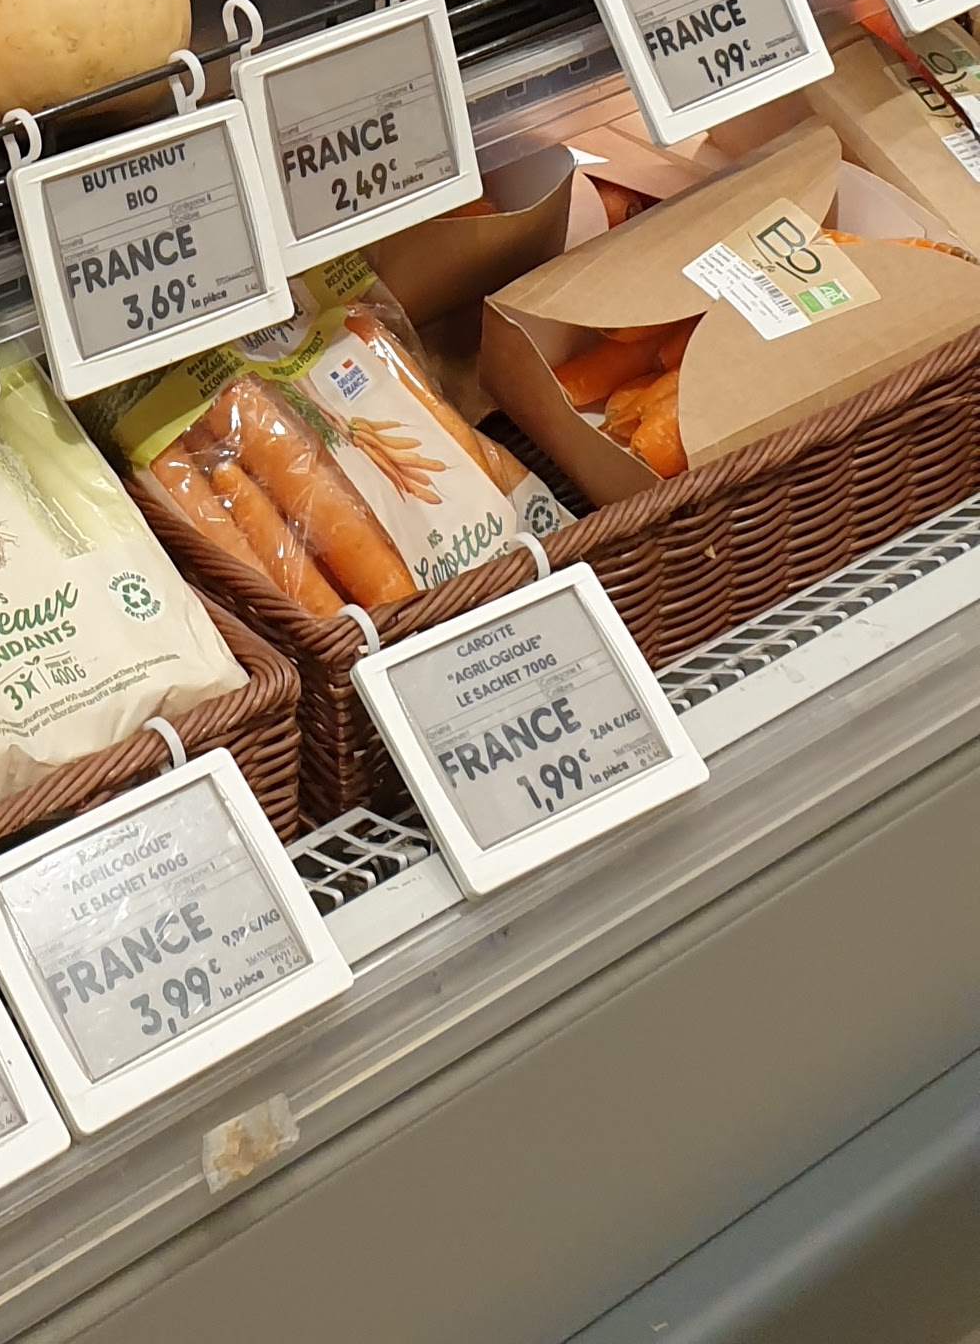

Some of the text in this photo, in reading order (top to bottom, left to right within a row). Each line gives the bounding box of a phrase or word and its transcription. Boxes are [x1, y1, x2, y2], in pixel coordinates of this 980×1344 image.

[81, 143, 188, 194] BUTTERNUT
[281, 111, 399, 184] FRANCE
[126, 186, 159, 212] BIO
[66, 223, 198, 300] FRANCE
[203, 288, 228, 308] pièce
[447, 634, 543, 686] "AGRILOGIQUE"
[456, 623, 516, 659] CAROTTE
[456, 653, 558, 708] LE SACHET 700G
[437, 696, 582, 790] FRANCE
[603, 760, 630, 782] pièce
[71, 852, 189, 921] LE SACHET 400G
[44, 901, 213, 1015] FRANCE
[234, 969, 266, 995] pièce
